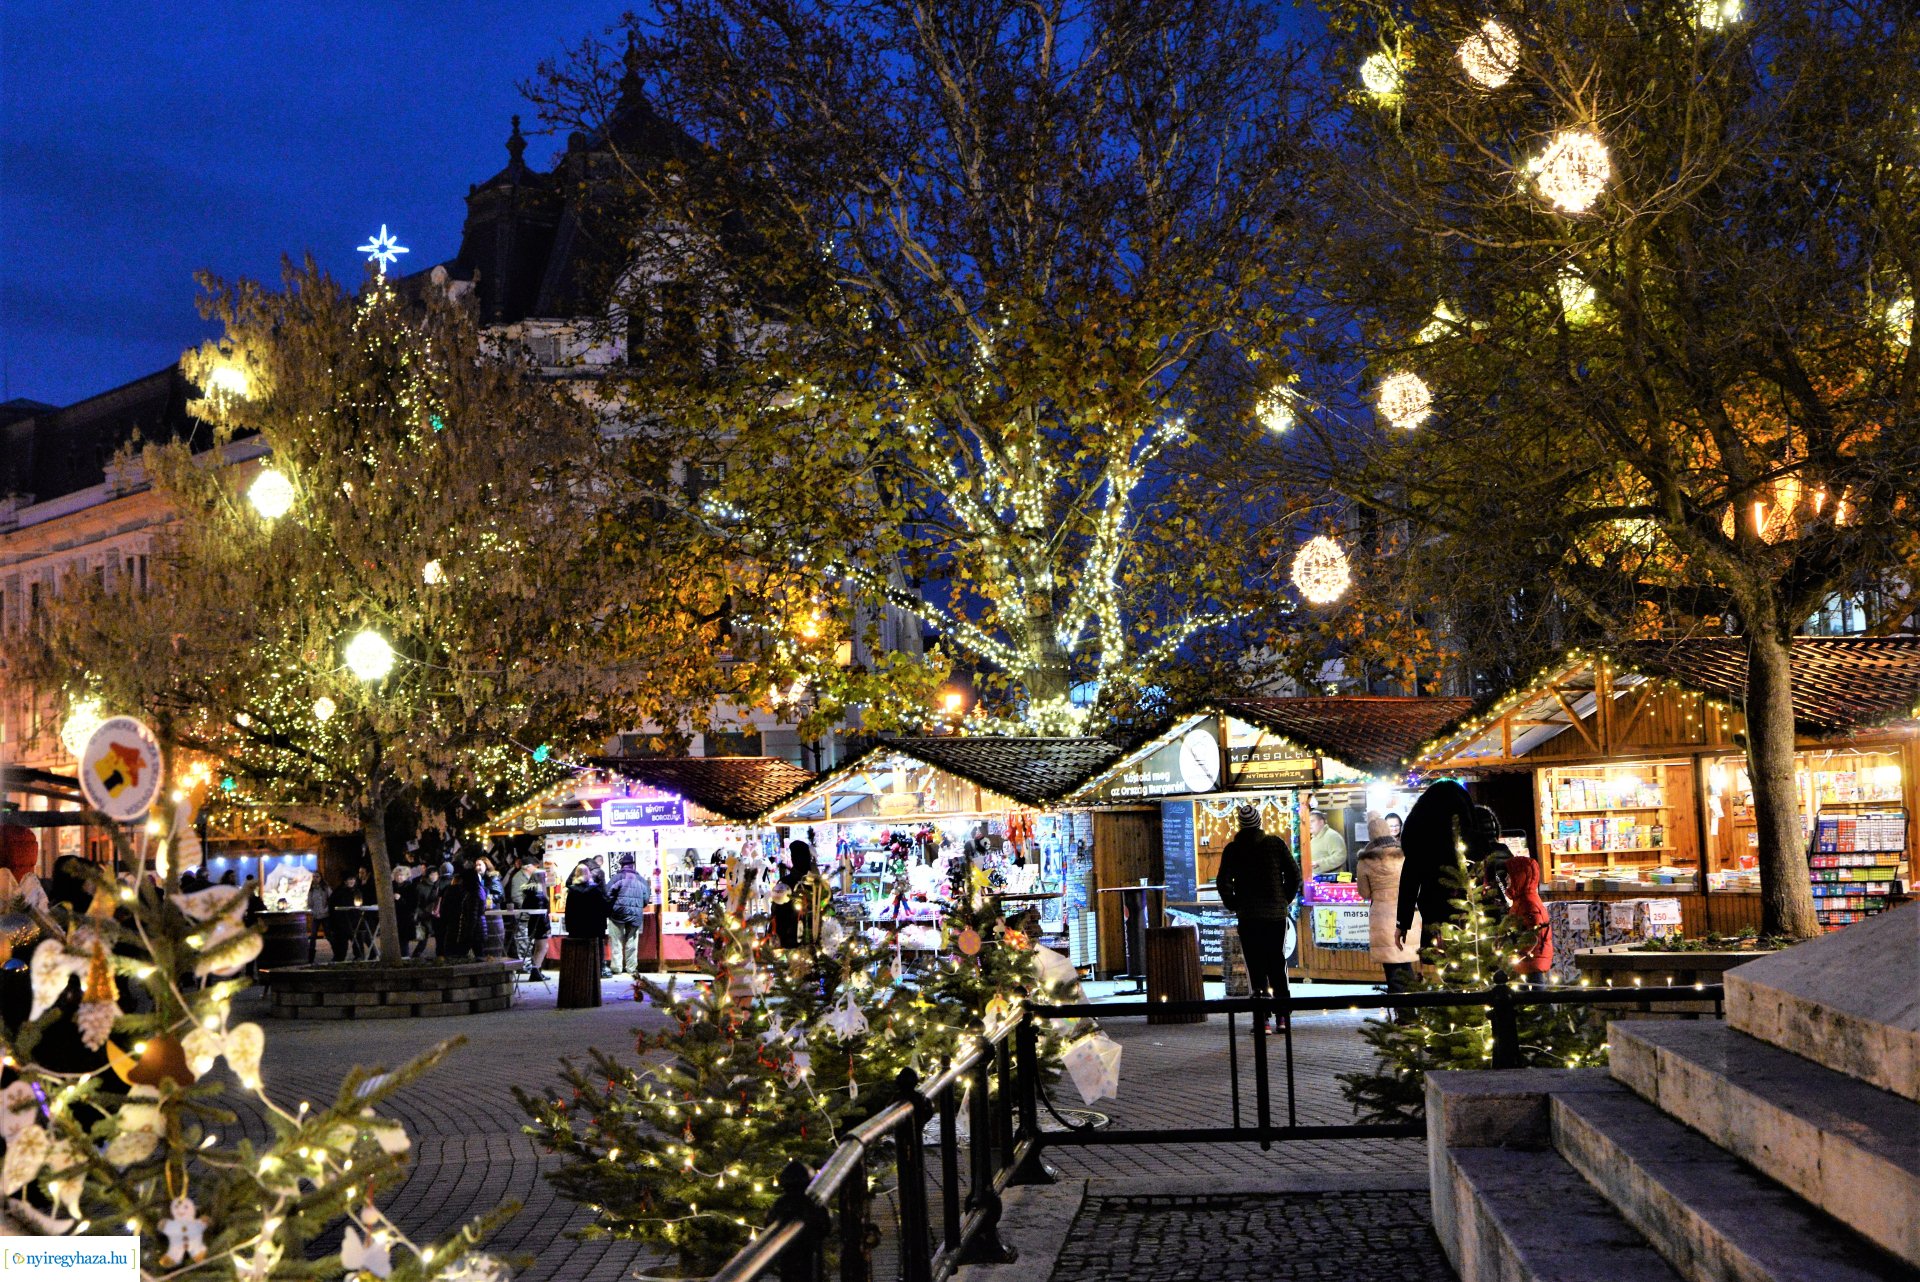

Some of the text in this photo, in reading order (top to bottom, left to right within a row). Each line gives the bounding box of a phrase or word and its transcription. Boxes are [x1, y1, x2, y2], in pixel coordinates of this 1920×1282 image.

[1152, 772, 1170, 782] meg
[1246, 771, 1301, 779] NYÍREGYHÁZA
[1111, 788, 1120, 796] az
[1653, 913, 1667, 921] 250
